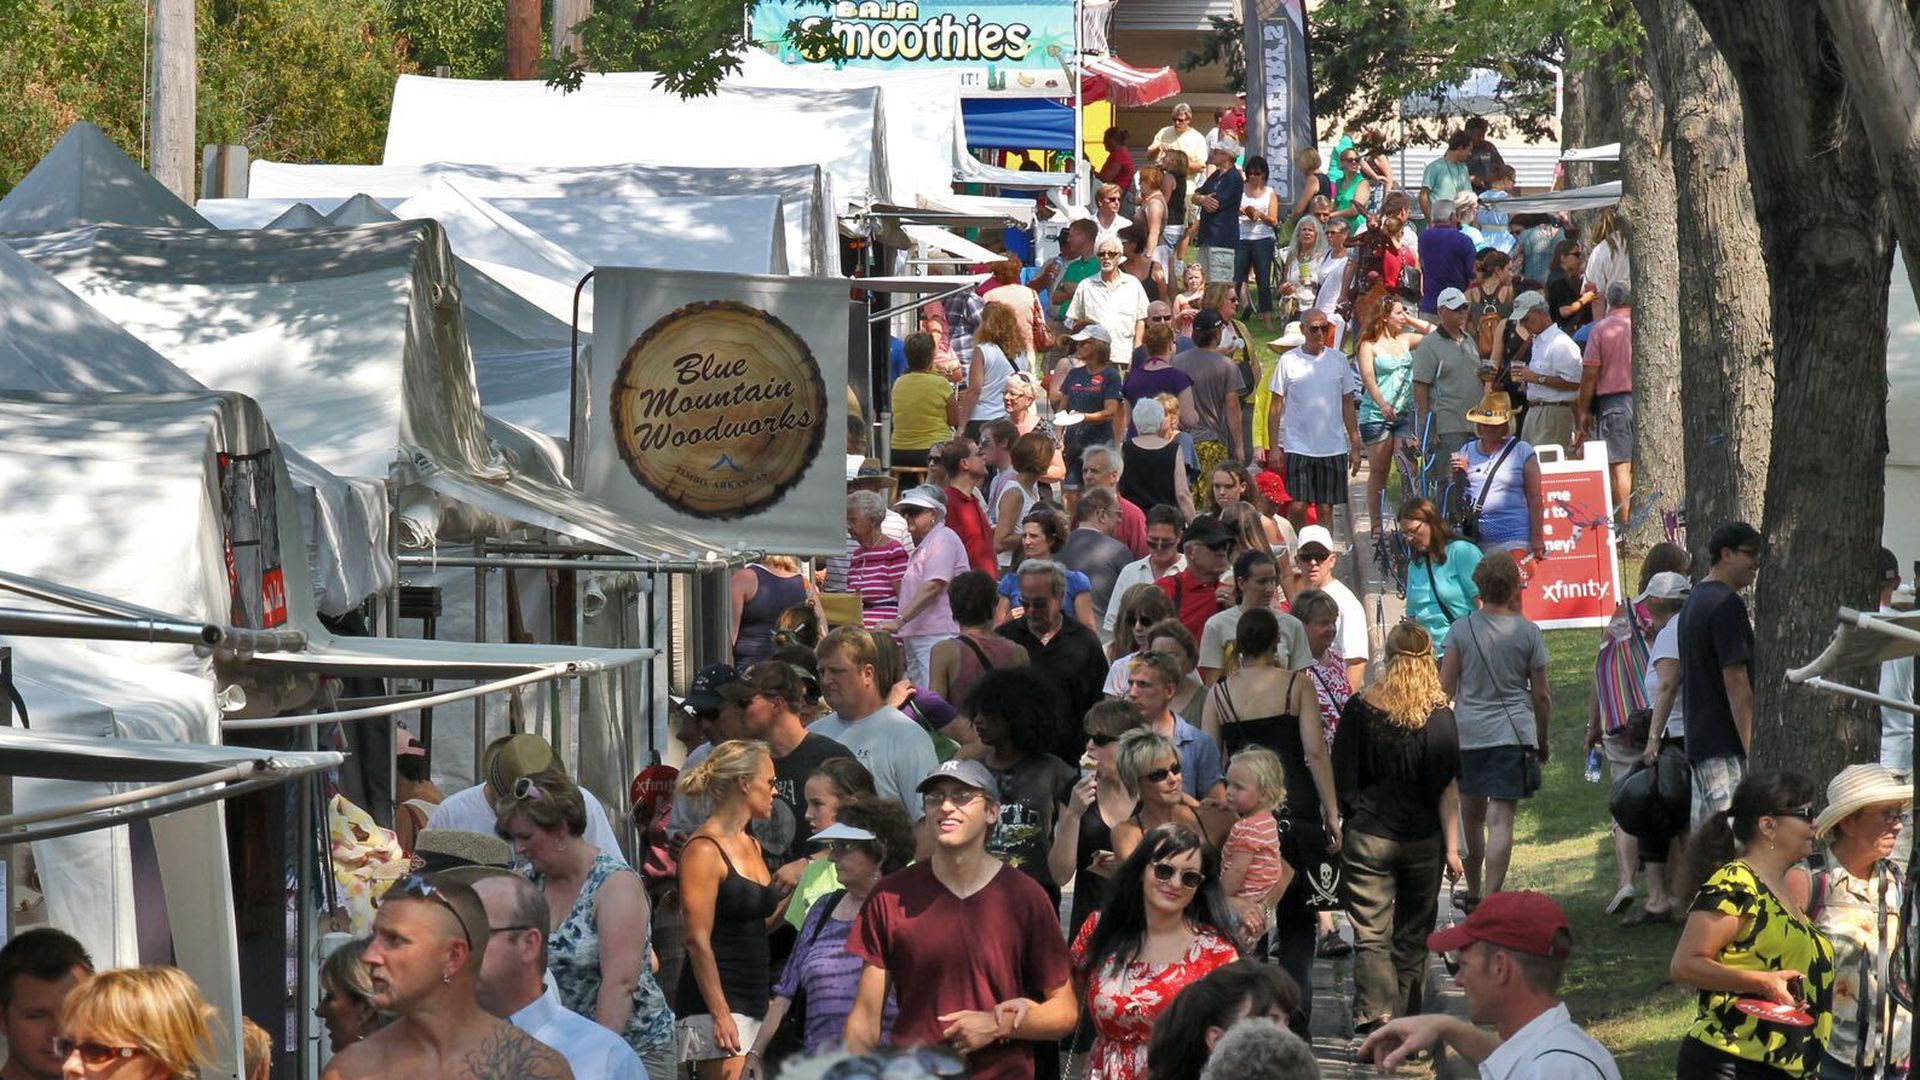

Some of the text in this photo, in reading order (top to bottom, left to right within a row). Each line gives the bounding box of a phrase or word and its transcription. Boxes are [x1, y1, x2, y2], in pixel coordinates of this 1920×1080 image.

[835, 0, 918, 20] BAJA
[673, 352, 749, 386] Blue
[639, 377, 795, 419] Mountain
[633, 403, 817, 451] Woodworks
[1547, 491, 1571, 502] me
